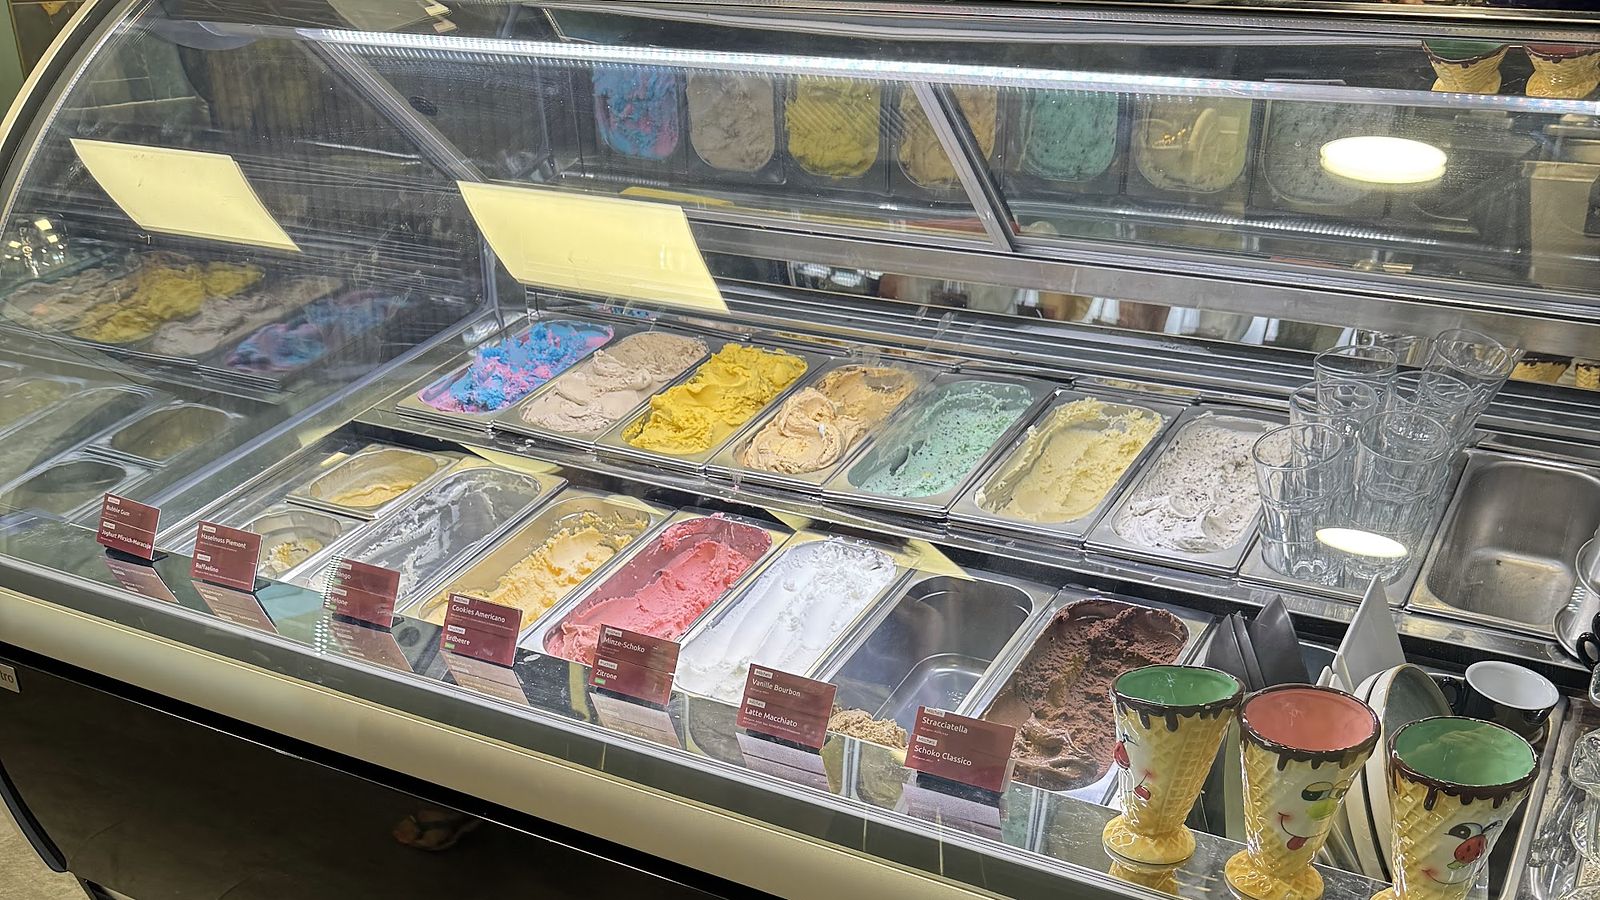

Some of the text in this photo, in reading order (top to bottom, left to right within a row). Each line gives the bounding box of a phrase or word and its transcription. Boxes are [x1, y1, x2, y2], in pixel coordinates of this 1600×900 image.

[200, 532, 226, 544] Haselnuss
[225, 538, 247, 550] Piemont
[451, 604, 475, 616] Cookies
[474, 610, 506, 623] Americano
[446, 634, 471, 646] Erdbeere
[603, 636, 645, 653] Minze-Schoko
[595, 668, 618, 681] Zitrone
[752, 678, 774, 690] Vanille
[773, 684, 801, 697] Bourbon
[744, 707, 763, 718] Latte
[763, 712, 798, 728] Macchiato
[921, 716, 968, 734] Stracciatella
[914, 744, 941, 758] Schoko
[941, 752, 972, 766] Classico
